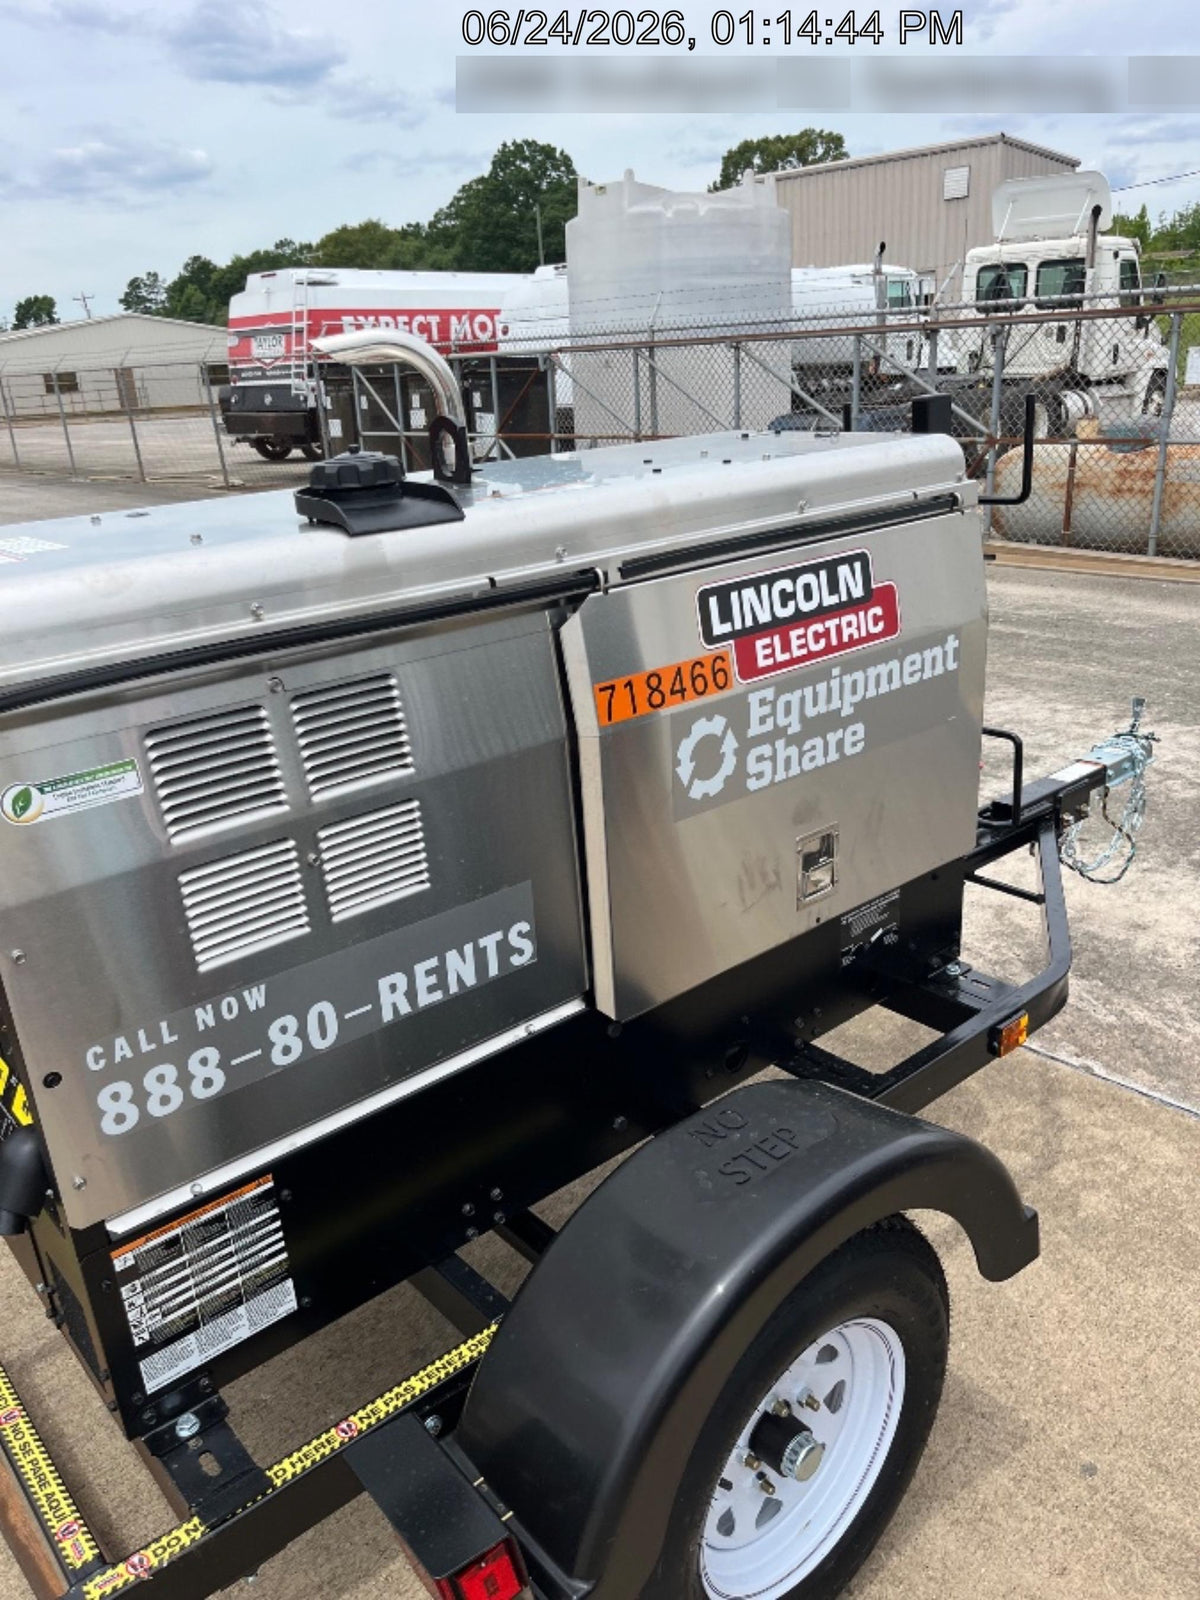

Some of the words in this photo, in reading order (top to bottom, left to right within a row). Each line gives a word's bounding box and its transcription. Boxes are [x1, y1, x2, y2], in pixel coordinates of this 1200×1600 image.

[708, 561, 864, 637] LINCOLN
[756, 606, 885, 668] ELECTRIC
[599, 655, 729, 722] 718466
[747, 634, 960, 738] Equipment
[746, 722, 865, 792] Share
[86, 1021, 178, 1071] CALL
[194, 984, 267, 1031] NOW
[97, 921, 534, 1136] 888-80-RENTS
[688, 1108, 749, 1147] NO
[718, 1128, 799, 1185] STEP
[357, 1406, 382, 1423] NE
[383, 1383, 416, 1411] PAS
[418, 1352, 465, 1383] TENEZ
[9, 1422, 26, 1441] NO
[18, 1440, 36, 1459] SE
[27, 1459, 52, 1493] PARE
[153, 1536, 182, 1557] DO
[289, 1435, 338, 1466] HERE
